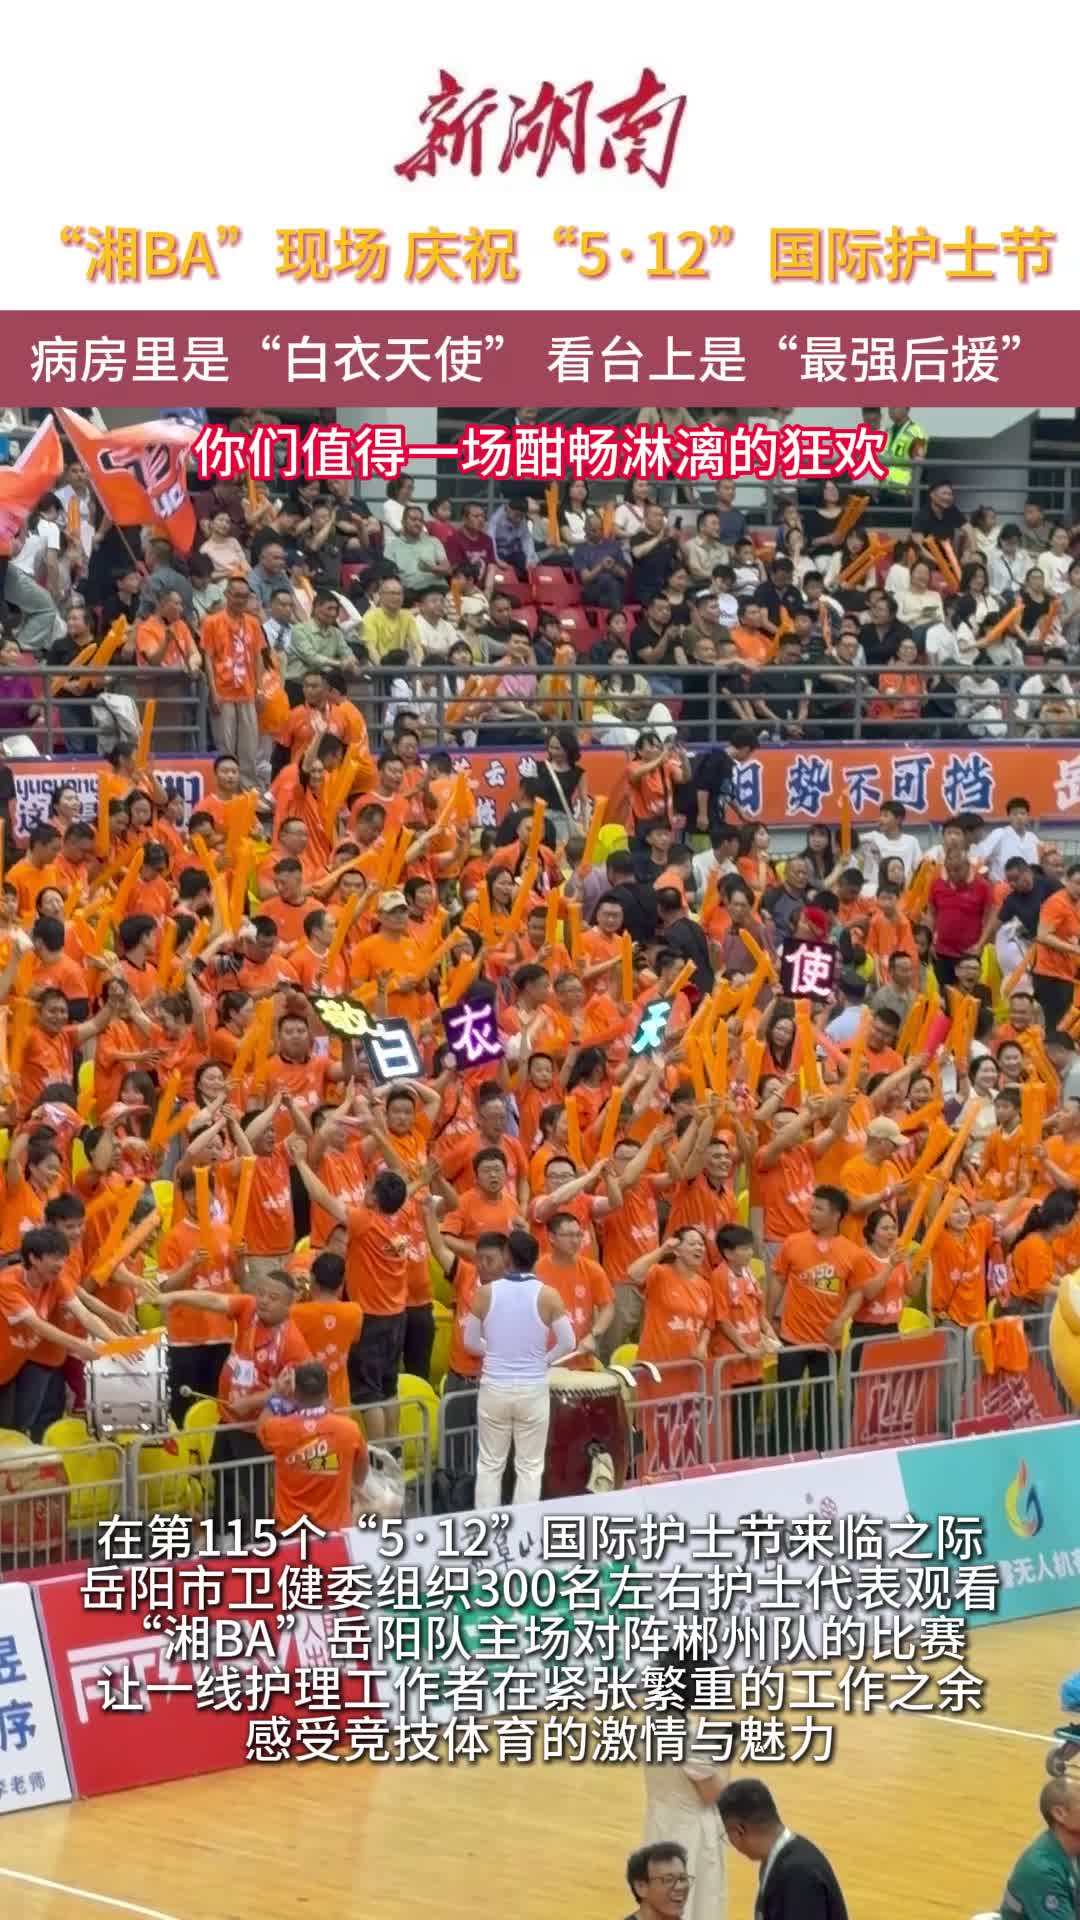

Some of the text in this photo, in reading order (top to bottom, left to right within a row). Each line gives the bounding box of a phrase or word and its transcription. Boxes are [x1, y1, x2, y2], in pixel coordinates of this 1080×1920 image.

[785, 942, 833, 996] 使
[371, 1022, 421, 1078] 白
[450, 1003, 502, 1061] 衣
[631, 1001, 671, 1053] 天
